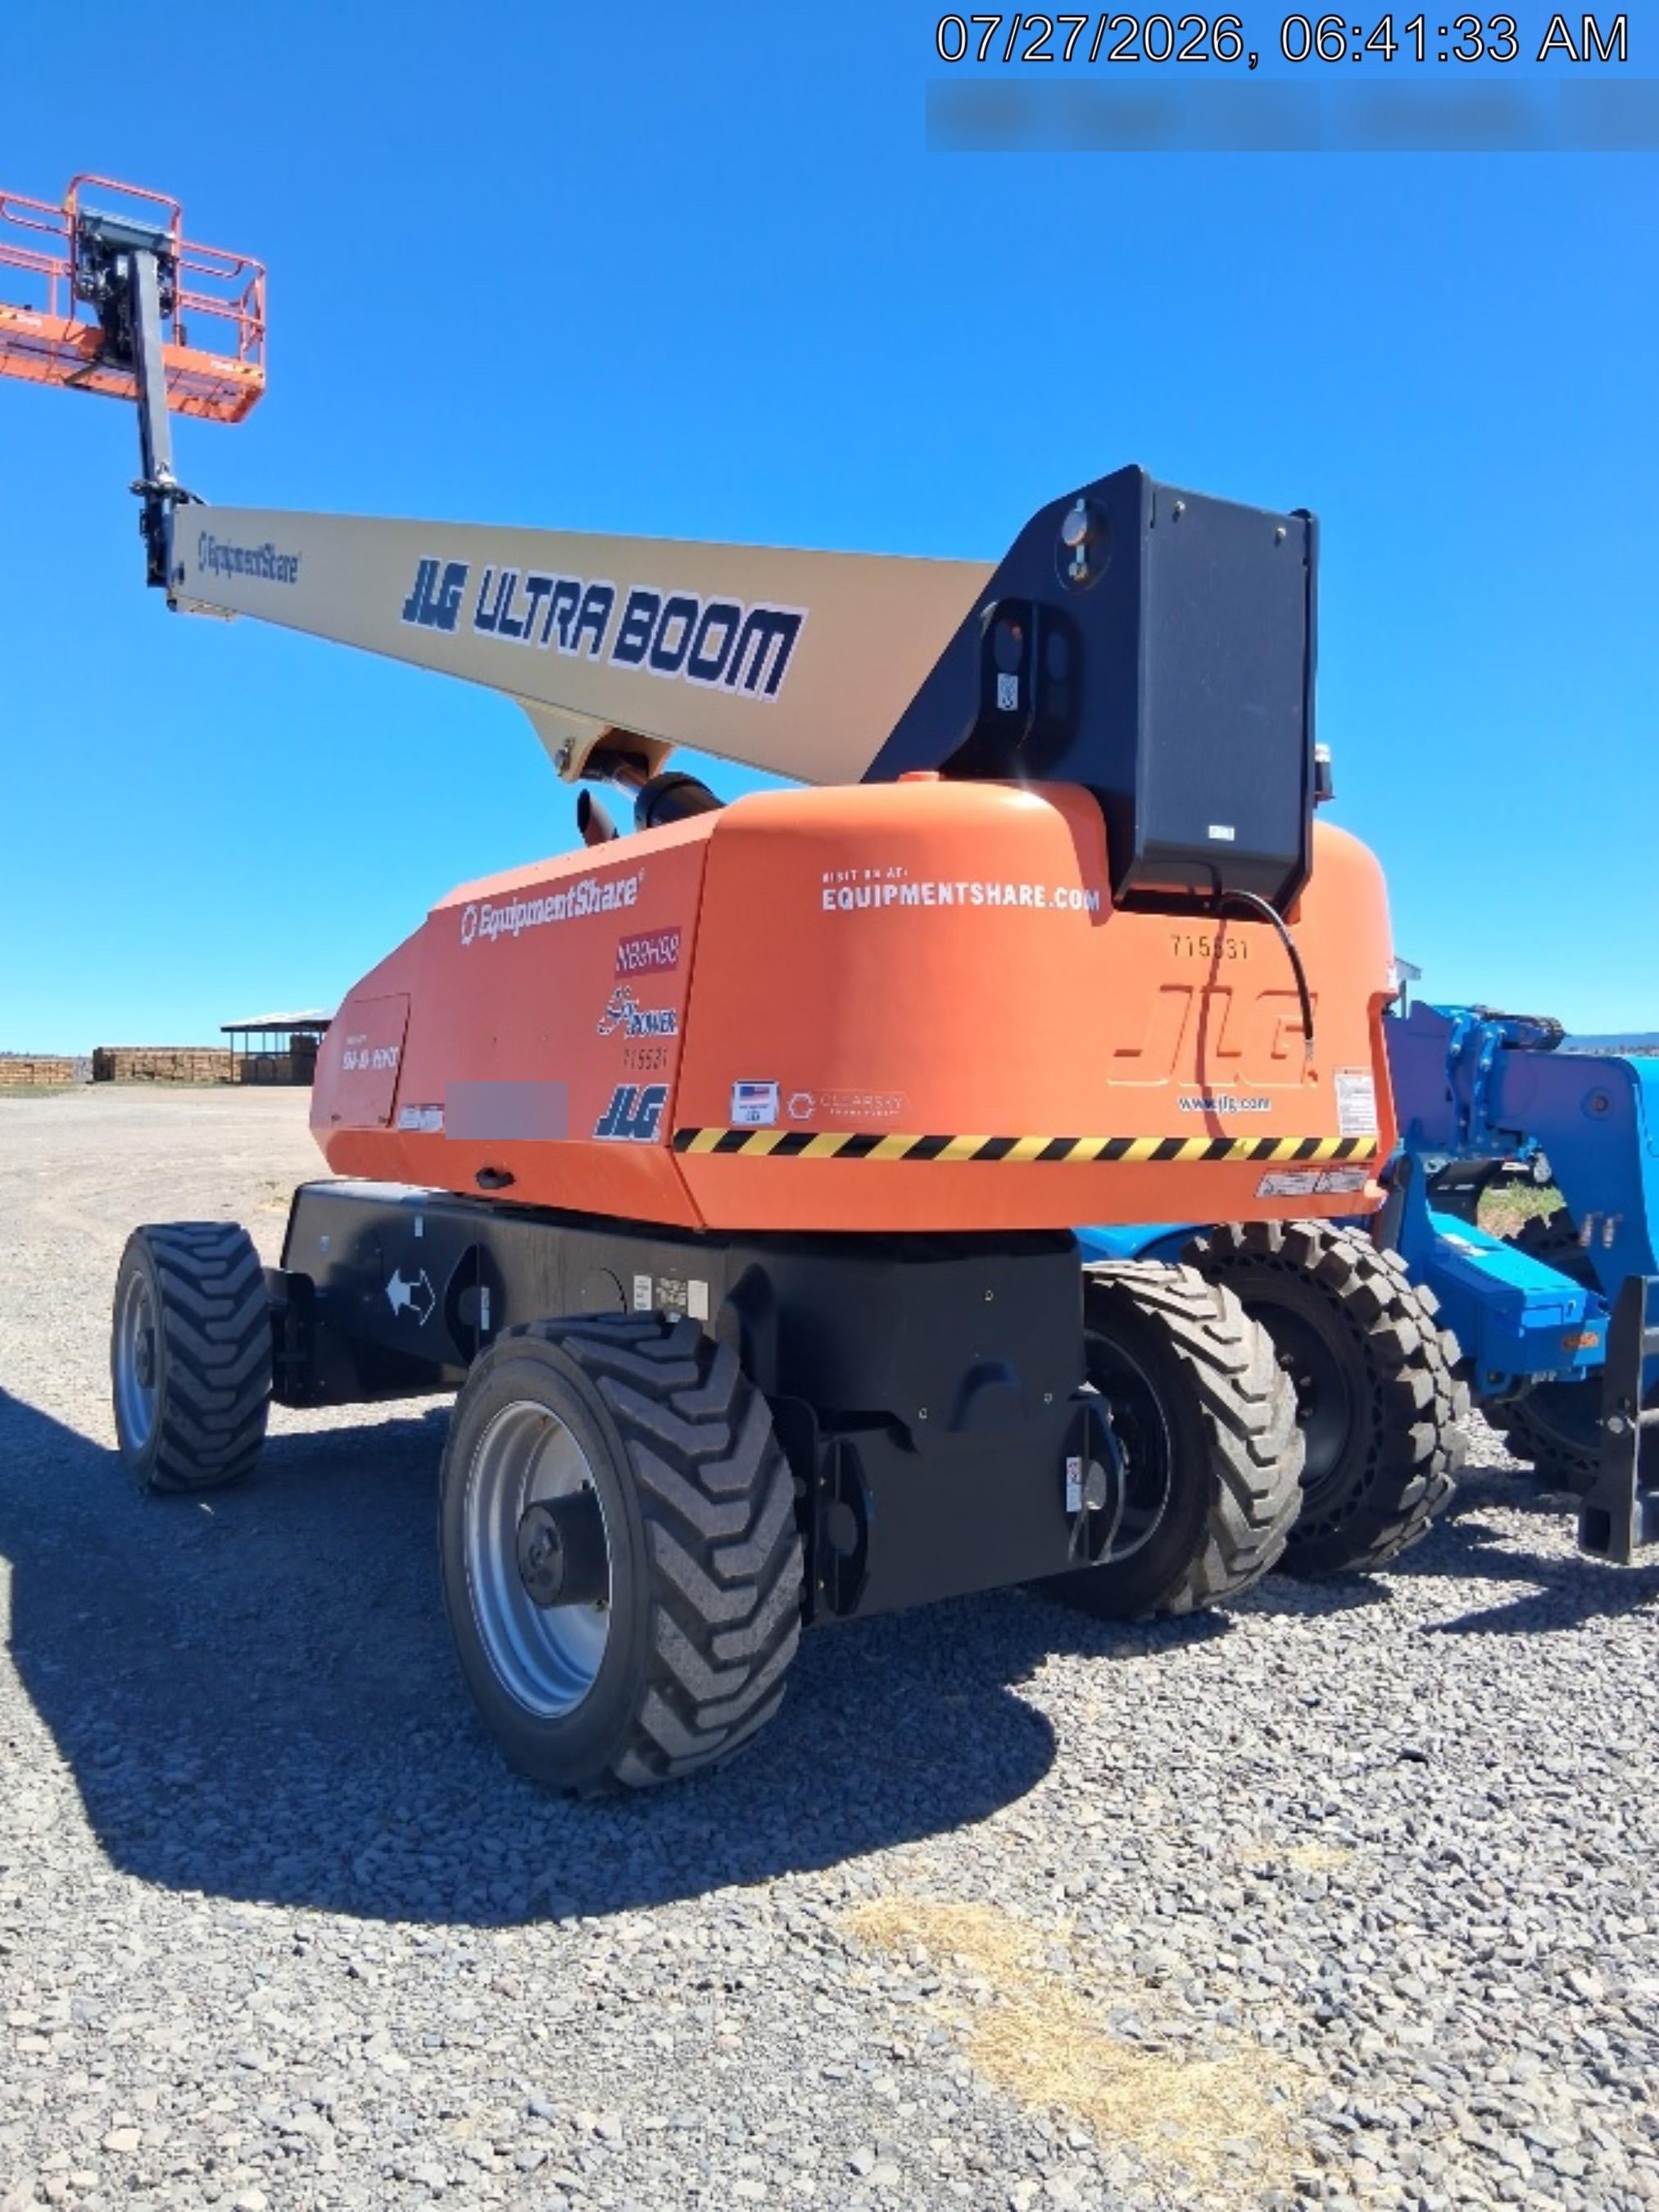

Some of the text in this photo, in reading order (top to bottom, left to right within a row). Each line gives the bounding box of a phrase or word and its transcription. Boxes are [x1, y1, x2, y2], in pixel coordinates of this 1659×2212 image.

[401, 555, 810, 704] JLG ULTRA BOOM
[478, 875, 639, 942] EquipmentShare
[822, 882, 1100, 911] EQUIPMENTSHARE.COM
[1105, 984, 1318, 1089] JLG
[592, 1083, 669, 1142] JLG
[1179, 1095, 1270, 1113] www.jlg.com
